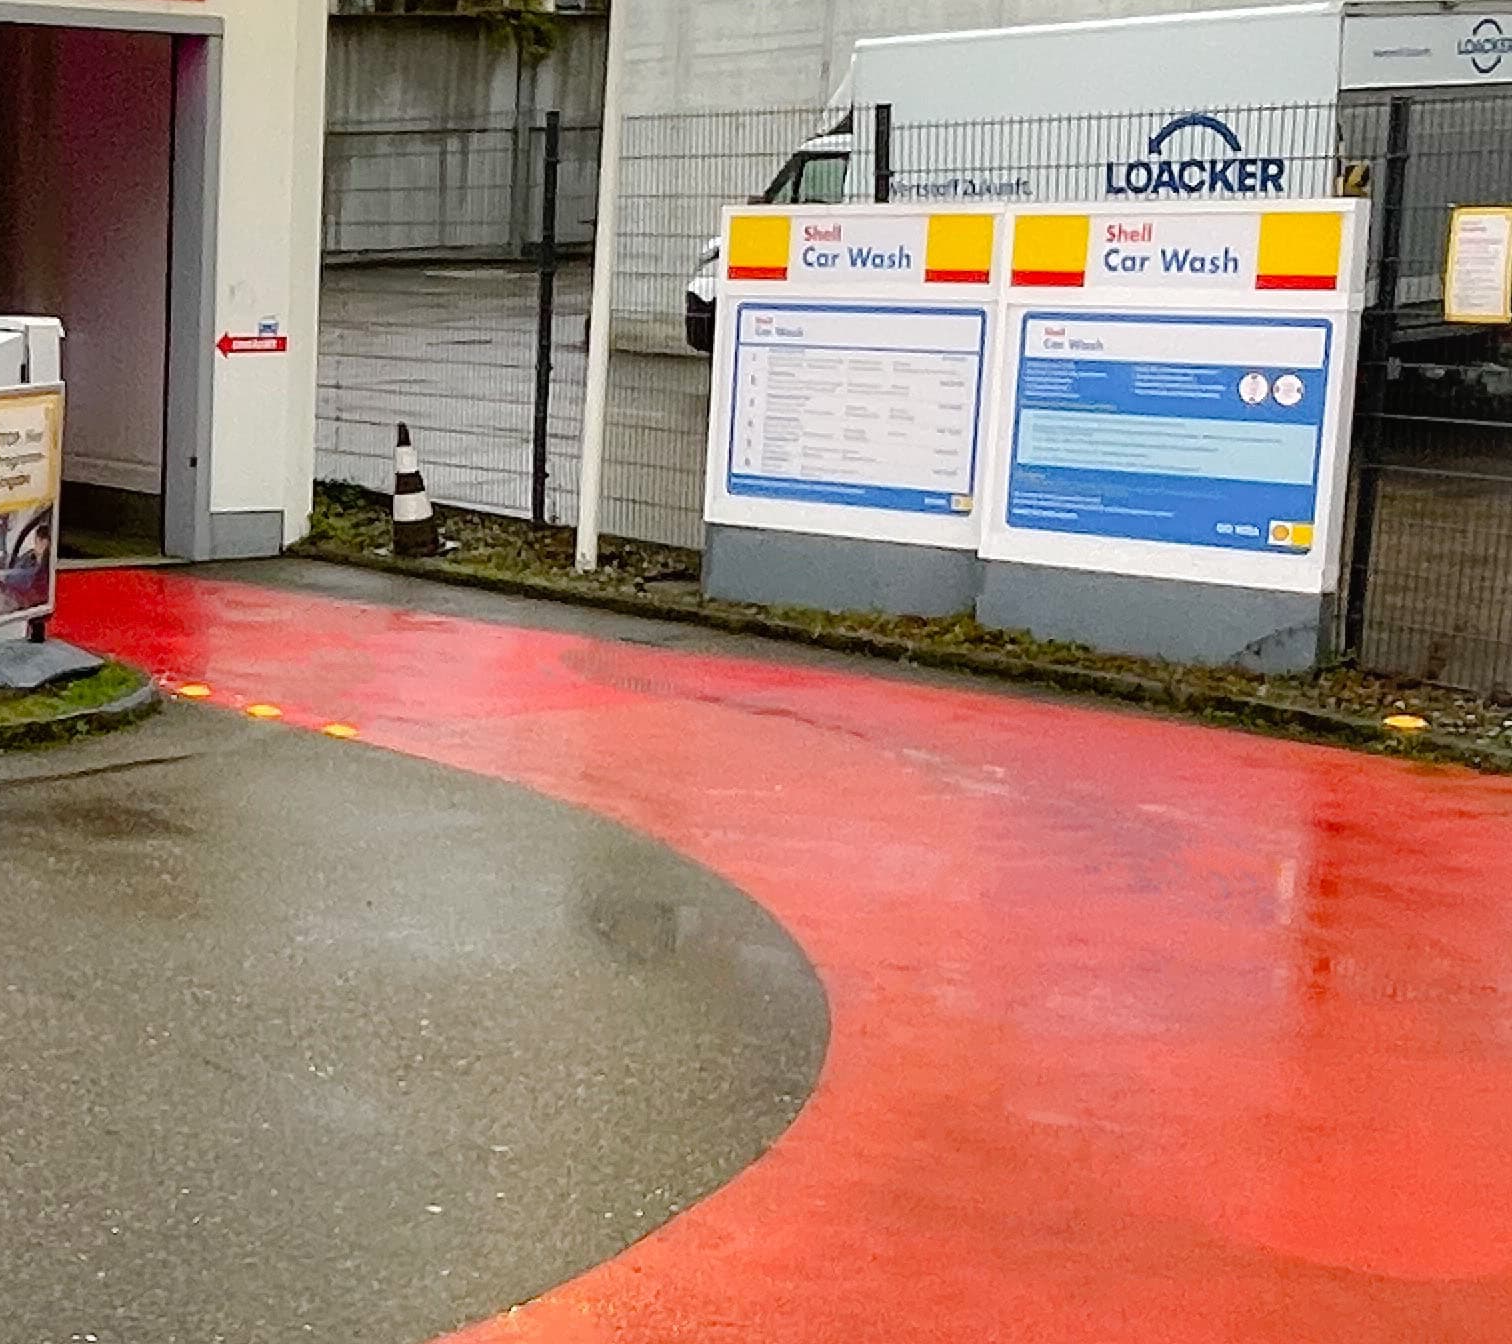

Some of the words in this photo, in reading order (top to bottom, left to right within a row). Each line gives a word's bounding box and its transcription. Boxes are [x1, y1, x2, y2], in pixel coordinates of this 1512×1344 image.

[1106, 159, 1285, 194] LOACKER
[804, 225, 841, 243] Shell
[1106, 223, 1153, 243] Shell
[802, 246, 840, 268] Car
[848, 246, 912, 269] Wash
[1104, 248, 1150, 272] Car
[1160, 246, 1239, 273] Wash
